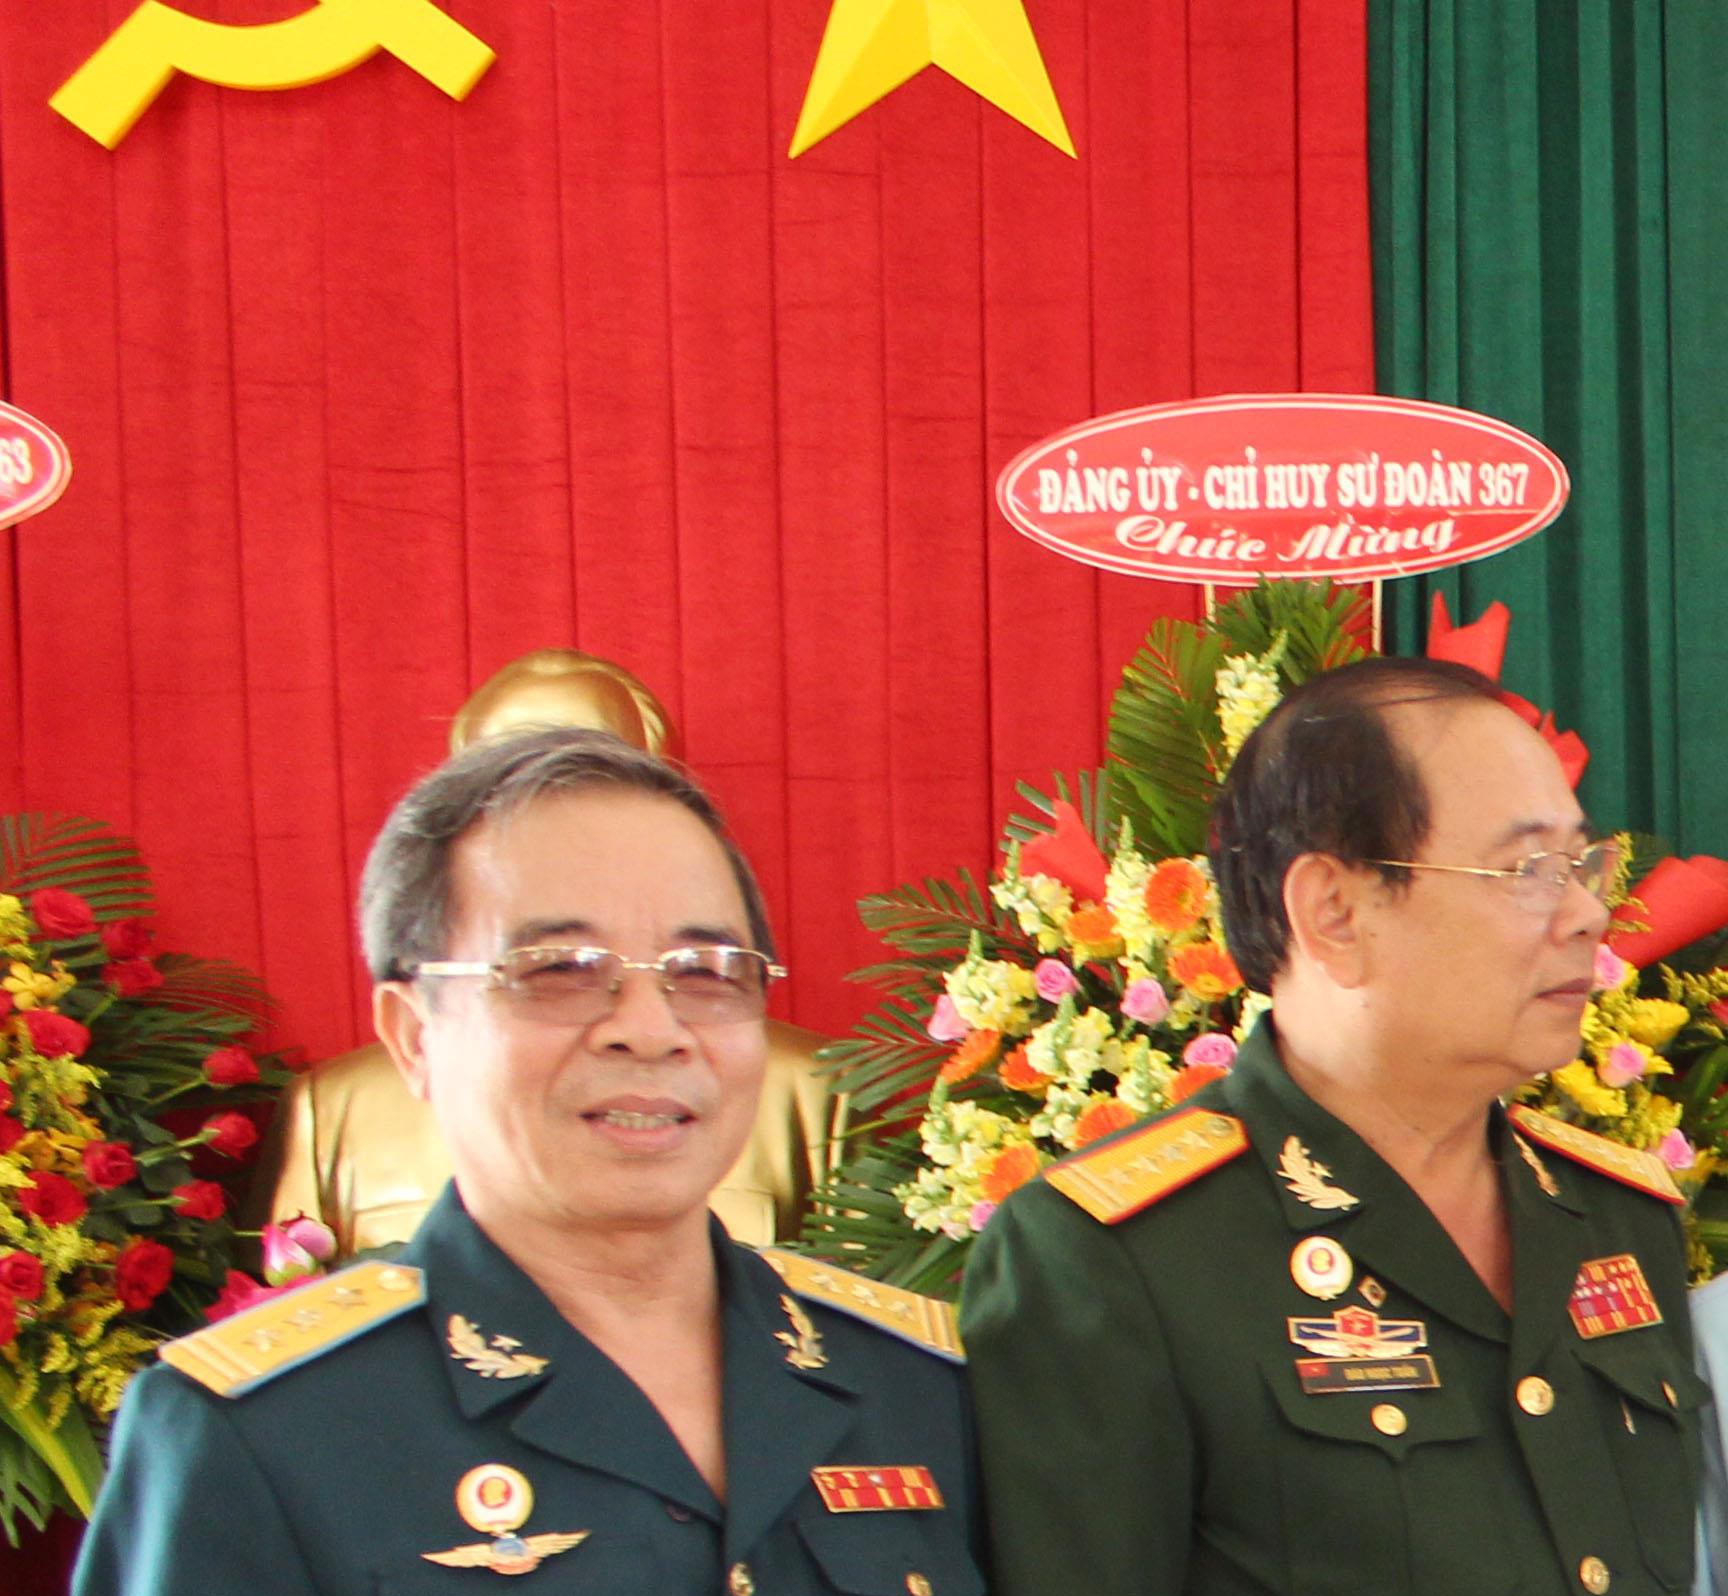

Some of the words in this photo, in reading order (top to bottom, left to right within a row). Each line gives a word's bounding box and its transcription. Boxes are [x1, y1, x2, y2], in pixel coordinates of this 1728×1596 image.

[1036, 448, 1131, 513] ĐẢNG
[1135, 447, 1182, 512] ỦY
[1203, 445, 1260, 510] CHỈ
[1264, 463, 1331, 509] HUY
[1336, 451, 1379, 508] SƯ
[1382, 448, 1472, 507] ĐOÀN
[1479, 462, 1530, 507] 367
[1115, 514, 1267, 562] Chúc
[1277, 512, 1456, 563] Mừng
